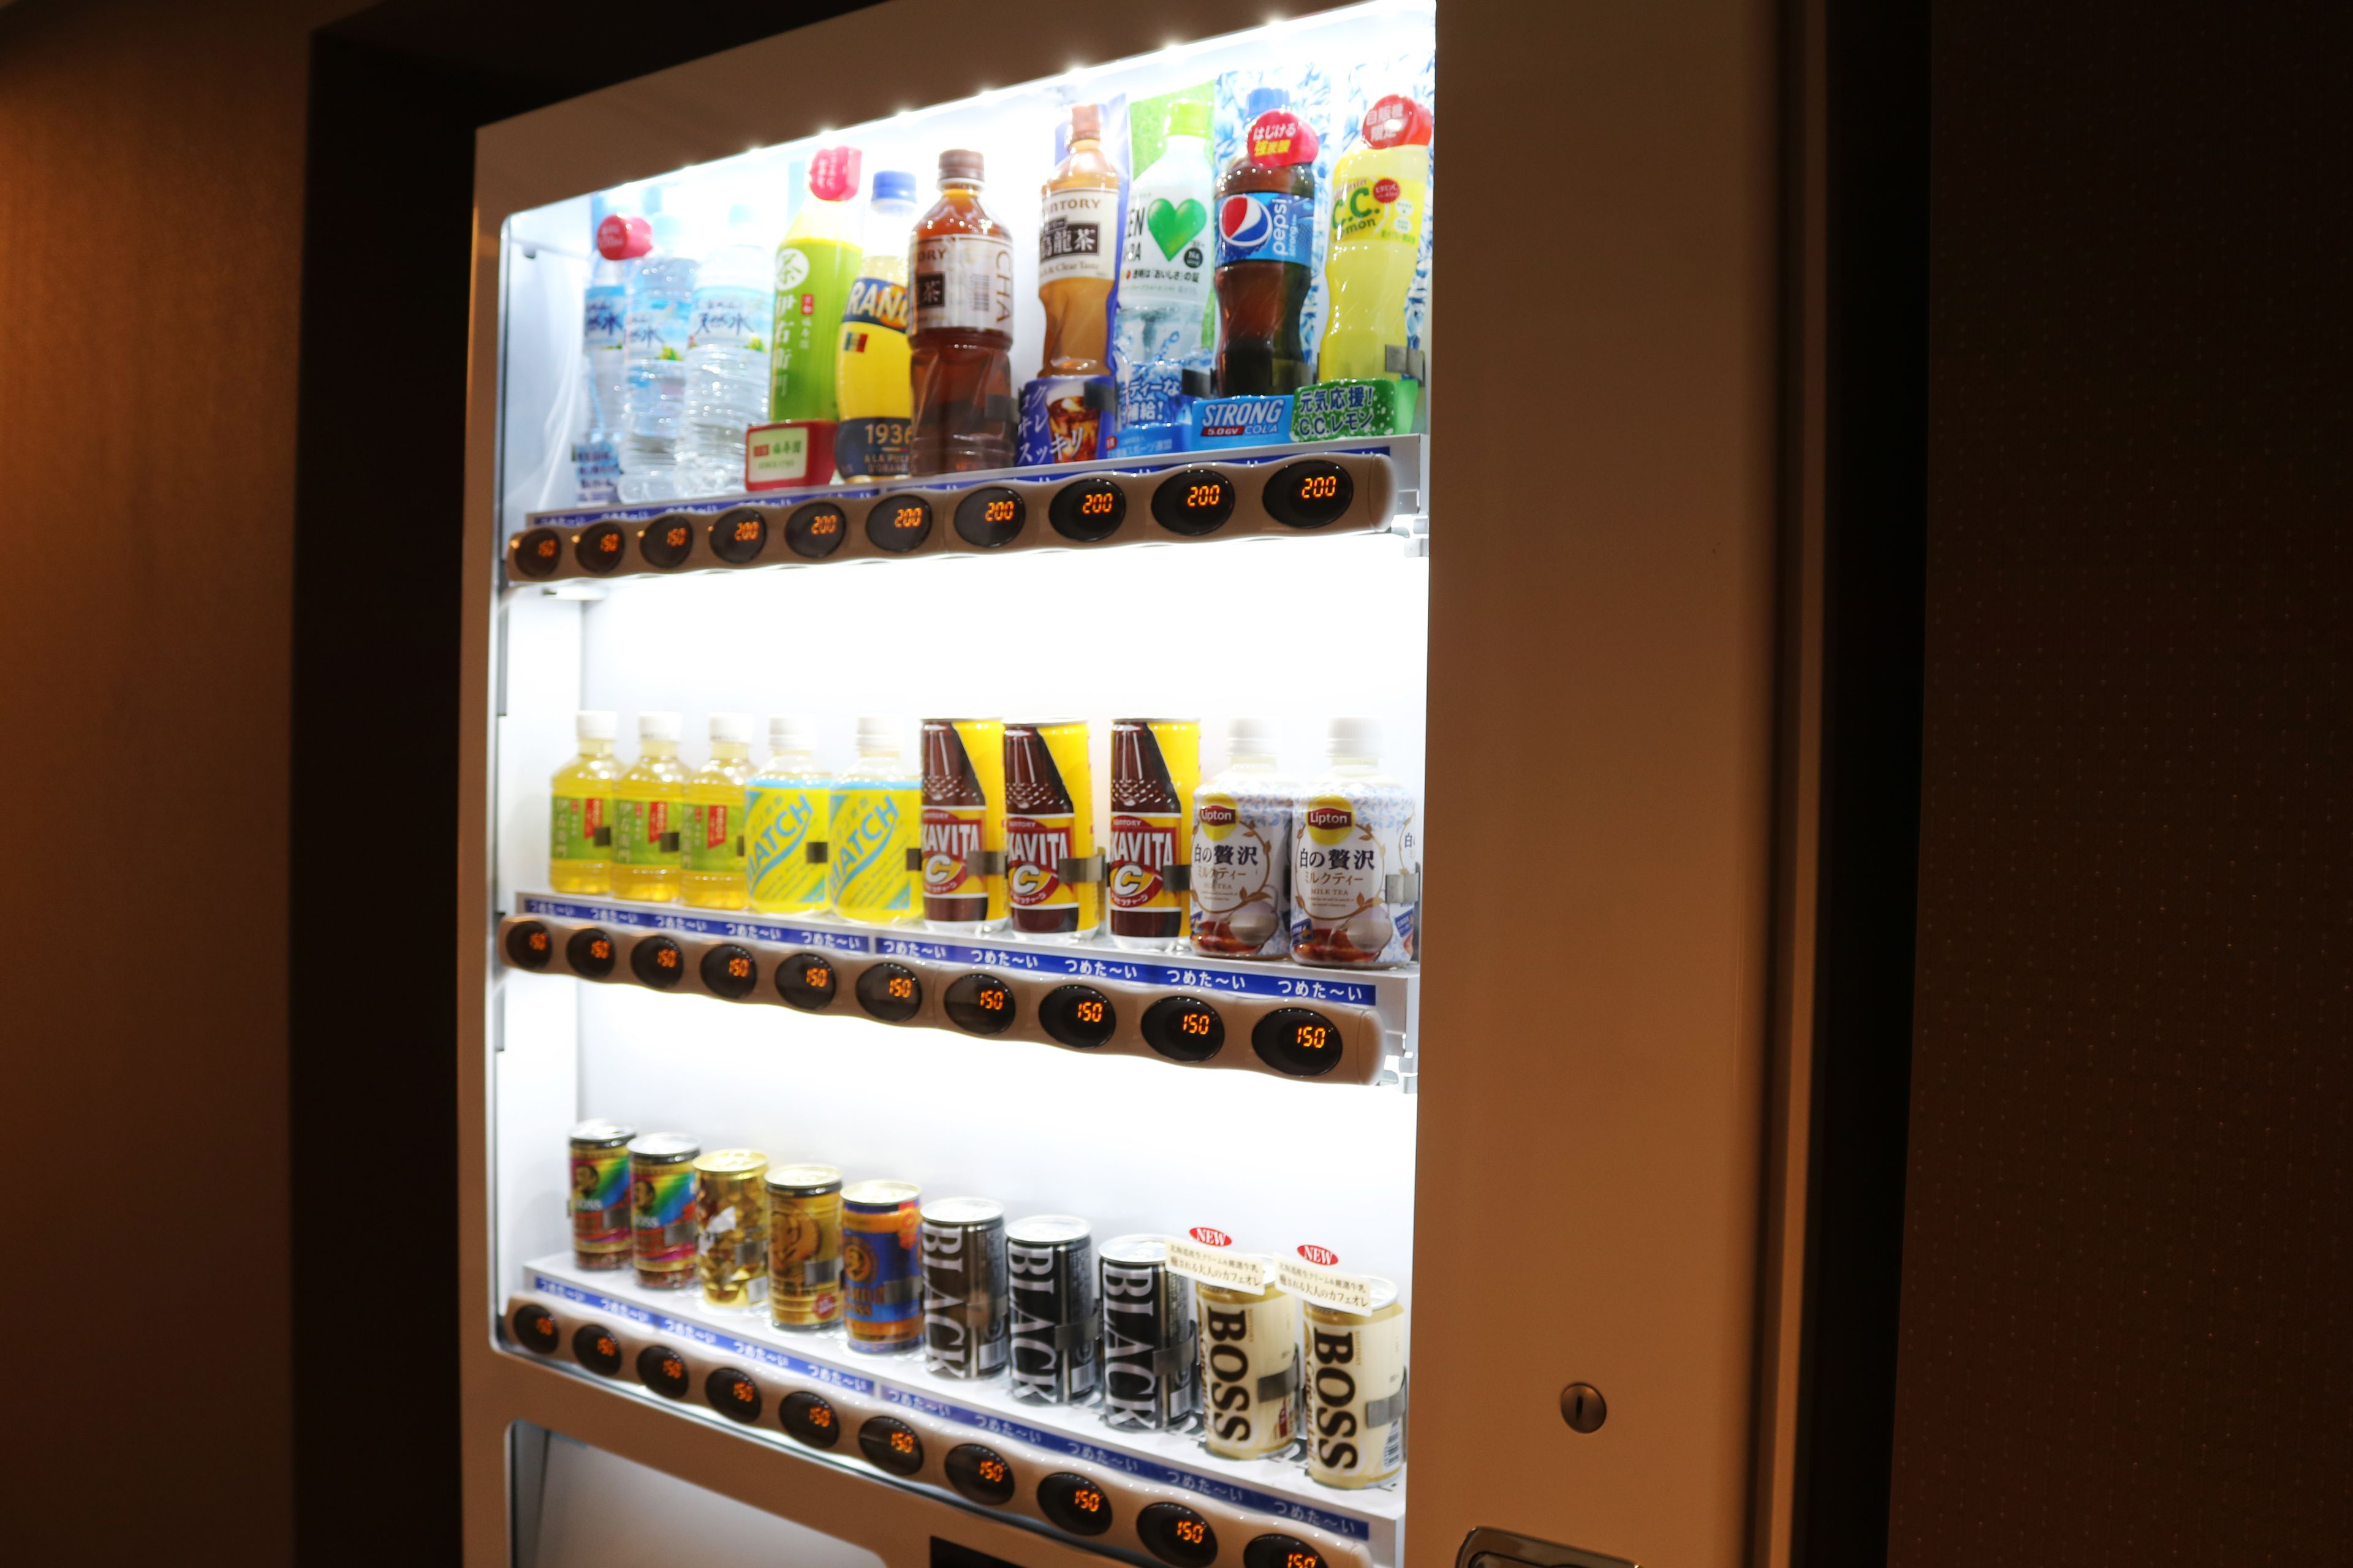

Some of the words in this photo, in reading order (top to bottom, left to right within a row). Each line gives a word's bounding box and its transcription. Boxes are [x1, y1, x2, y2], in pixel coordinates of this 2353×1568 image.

[1333, 187, 1381, 229] C.C.
[1273, 198, 1292, 256] pepsi
[996, 250, 1010, 322] CHA
[1300, 387, 1374, 412] 元気応援!
[1202, 400, 1284, 426] STRONG
[1299, 413, 1374, 435] C.C.レモン
[1245, 424, 1278, 435] COLA
[1187, 485, 1220, 507] 200
[1301, 475, 1337, 499] 200
[985, 501, 1014, 521] 200
[1082, 493, 1113, 513] 200
[811, 515, 836, 534] 200
[895, 507, 922, 528] 200
[735, 521, 759, 540] 200
[1200, 809, 1232, 821] Lipton
[1309, 812, 1347, 825] Lipton
[1194, 844, 1258, 866] 白の贅沢
[1300, 848, 1375, 871] 白の贅沢
[925, 854, 952, 884] C
[1012, 864, 1040, 895] C
[1114, 863, 1143, 896] C
[1305, 871, 1364, 886] ミルクティー
[806, 968, 828, 988] 150
[889, 977, 912, 998] 150
[980, 990, 1004, 1010] 150
[1077, 1002, 1103, 1023] 150
[1182, 1014, 1210, 1035] 150
[1297, 1026, 1326, 1048] 150
[1195, 1228, 1227, 1246] NEW
[1303, 1245, 1333, 1265] NEW
[922, 1225, 966, 1379] BLACK
[1008, 1241, 1058, 1404] BLACK
[1103, 1263, 1156, 1430] BLACK
[1208, 1306, 1251, 1442] BOSS
[1314, 1327, 1358, 1471] BOSS
[890, 1431, 915, 1453] 150
[980, 1460, 1004, 1482] 150
[1074, 1489, 1100, 1512] 150
[1176, 1520, 1205, 1543] 150
